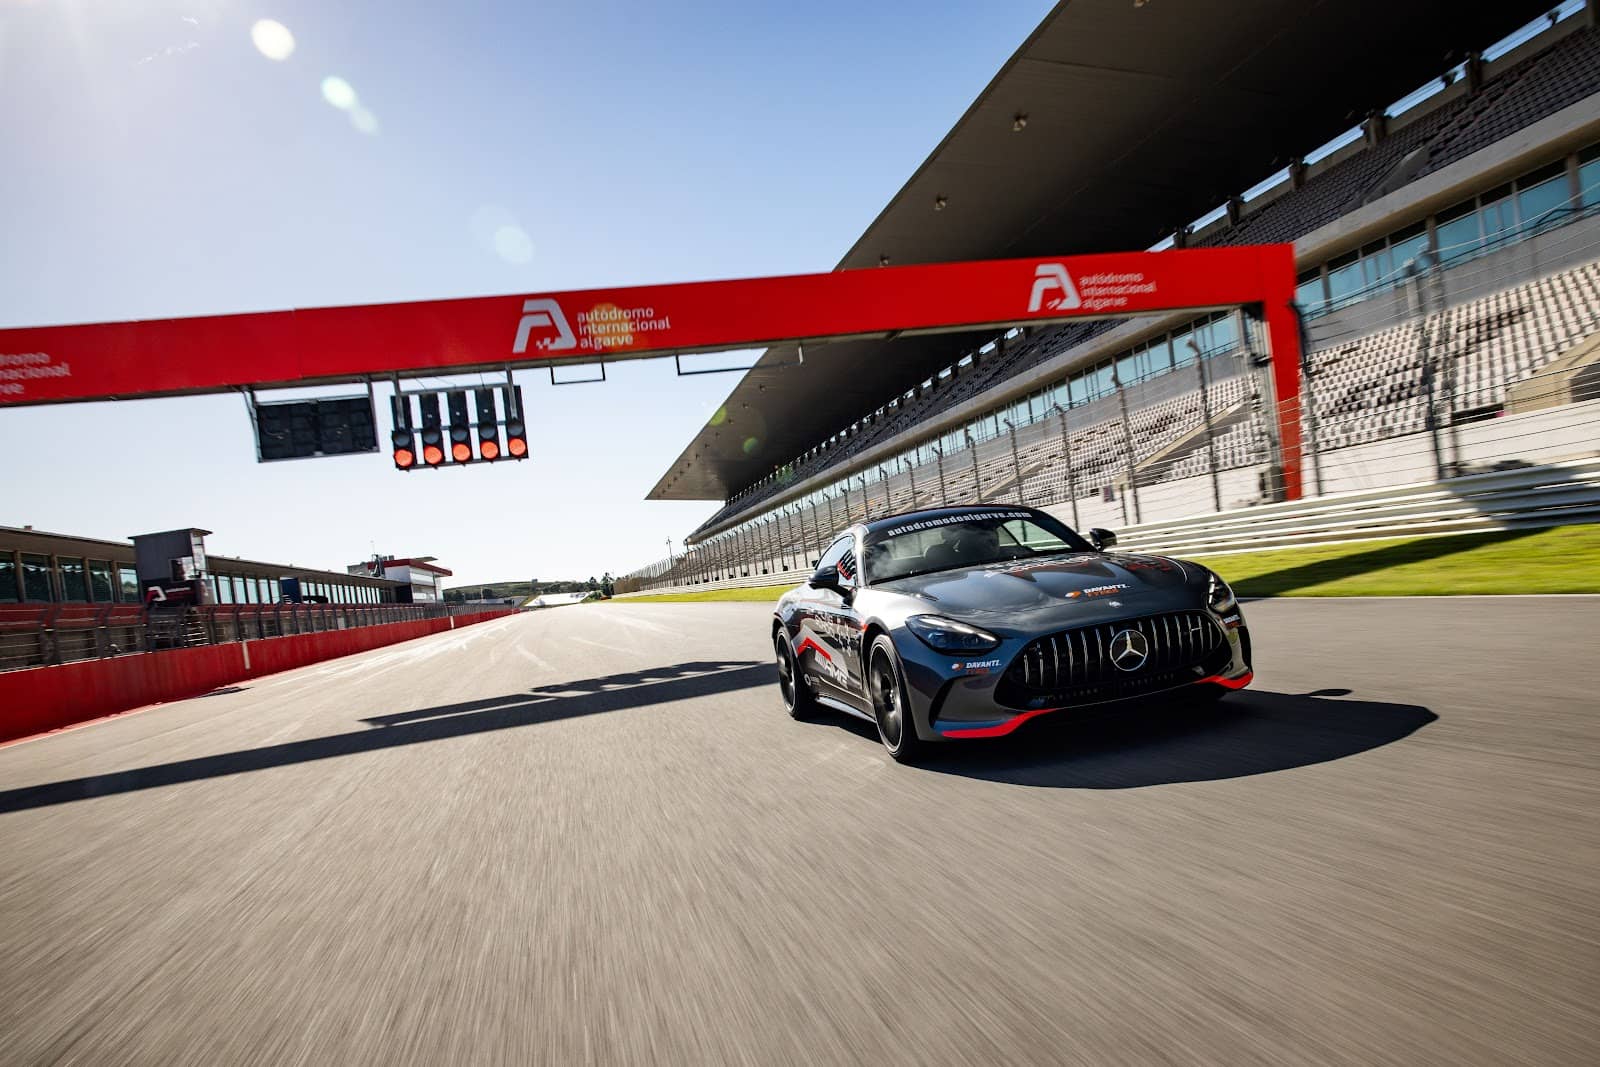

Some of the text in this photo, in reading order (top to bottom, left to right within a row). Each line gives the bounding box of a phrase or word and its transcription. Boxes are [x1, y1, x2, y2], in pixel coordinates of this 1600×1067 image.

[578, 315, 671, 336] internacional
[580, 333, 634, 351] algarve
[887, 511, 1033, 537] autodromodoalgarve.com
